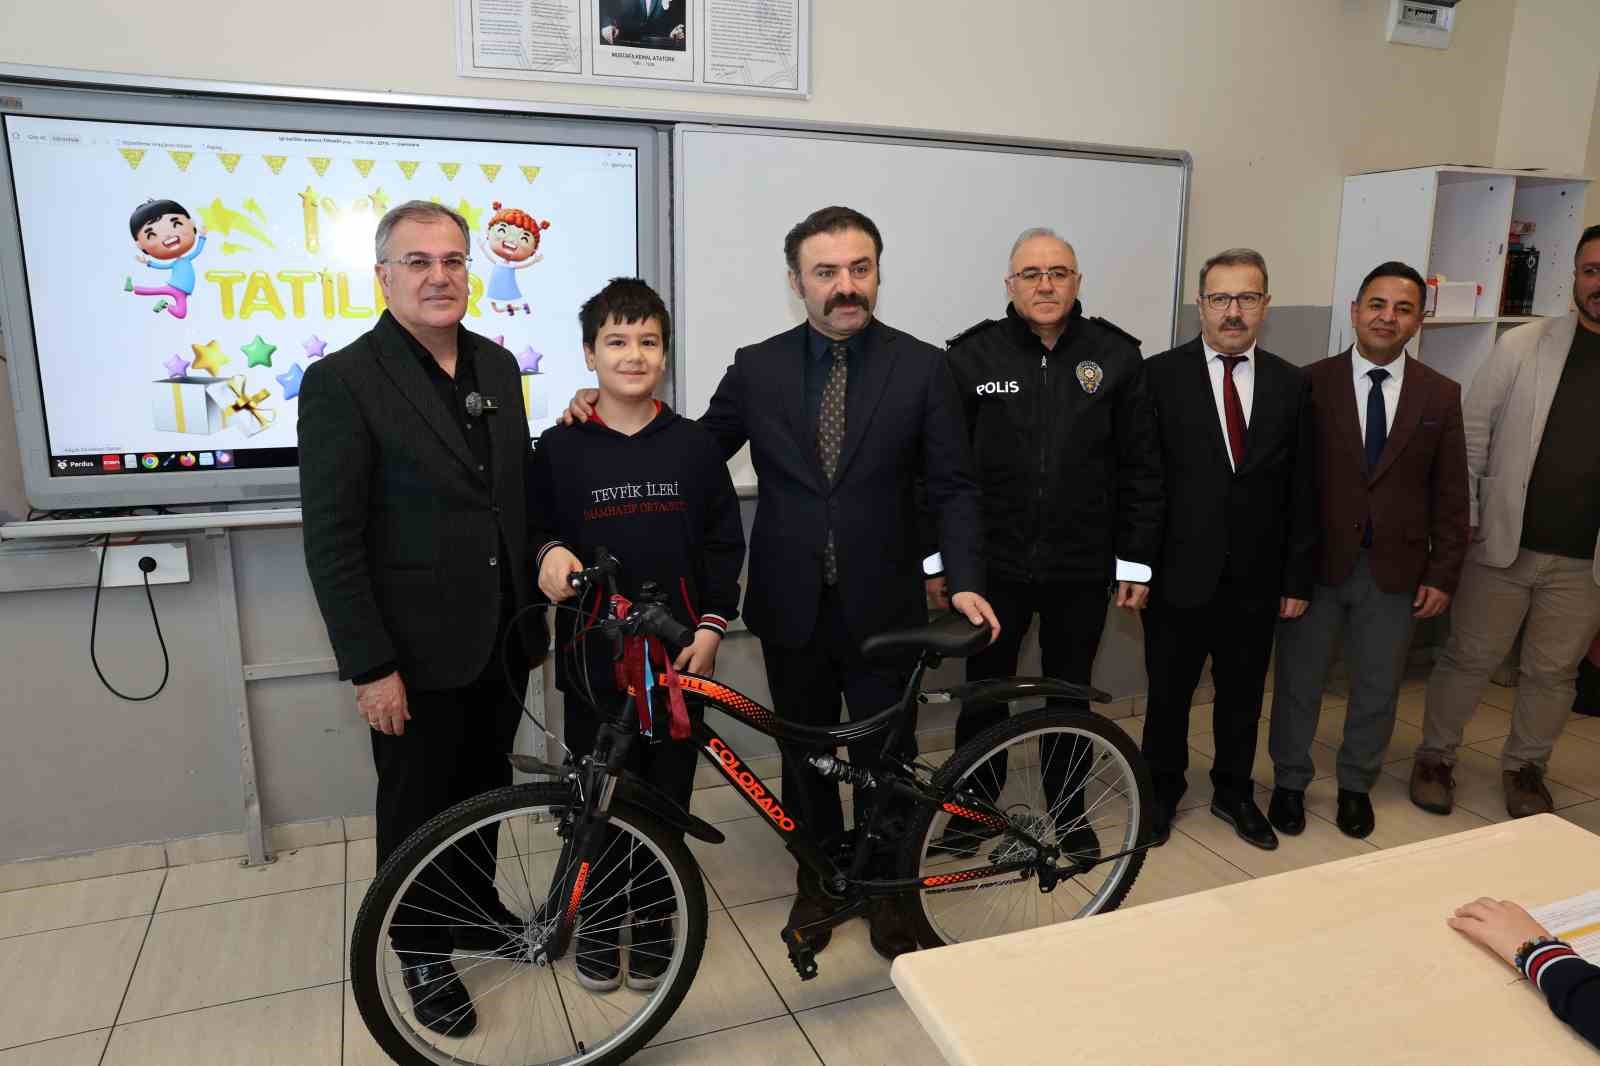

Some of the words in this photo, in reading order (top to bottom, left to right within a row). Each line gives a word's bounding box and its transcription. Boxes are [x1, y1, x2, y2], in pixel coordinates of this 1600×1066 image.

[205, 266, 484, 320] TATİLR
[591, 483, 643, 503] TEVFİK
[646, 481, 679, 496] İLERİ
[709, 737, 797, 832] COLORADO
